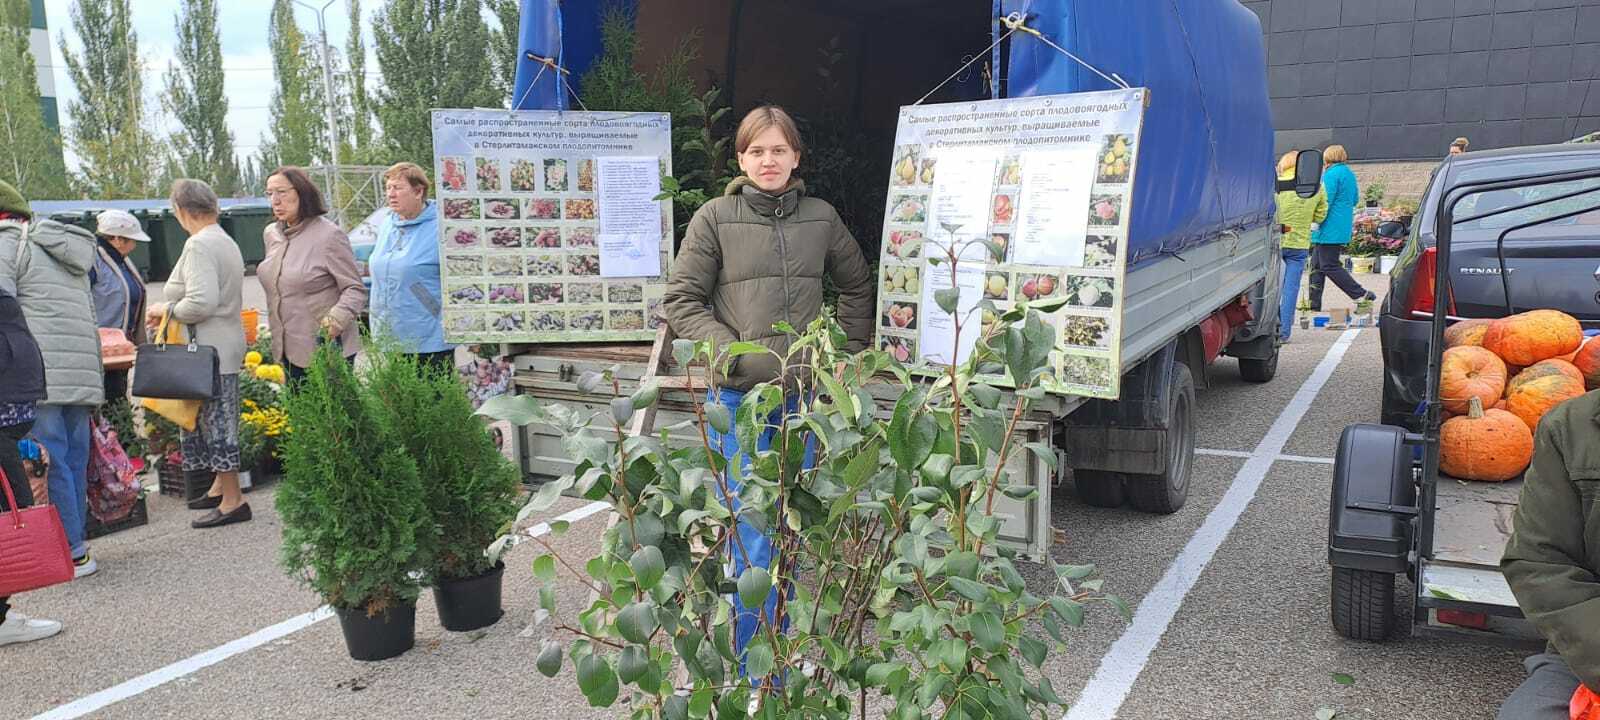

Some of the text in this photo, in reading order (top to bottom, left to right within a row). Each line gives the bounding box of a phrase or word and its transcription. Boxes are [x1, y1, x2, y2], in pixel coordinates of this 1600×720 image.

[908, 115, 936, 123] Самые
[1020, 107, 1045, 117] сорта
[1047, 102, 1128, 115] плодовоягодных
[444, 117, 475, 125] Самые
[564, 121, 588, 129] сорта
[926, 126, 983, 136] декоративных
[1022, 119, 1101, 132] выращиваемые
[481, 141, 560, 149] Стерлитамакском
[1013, 134, 1091, 145] плодопитомнике
[1460, 267, 1515, 275] RENAUT
